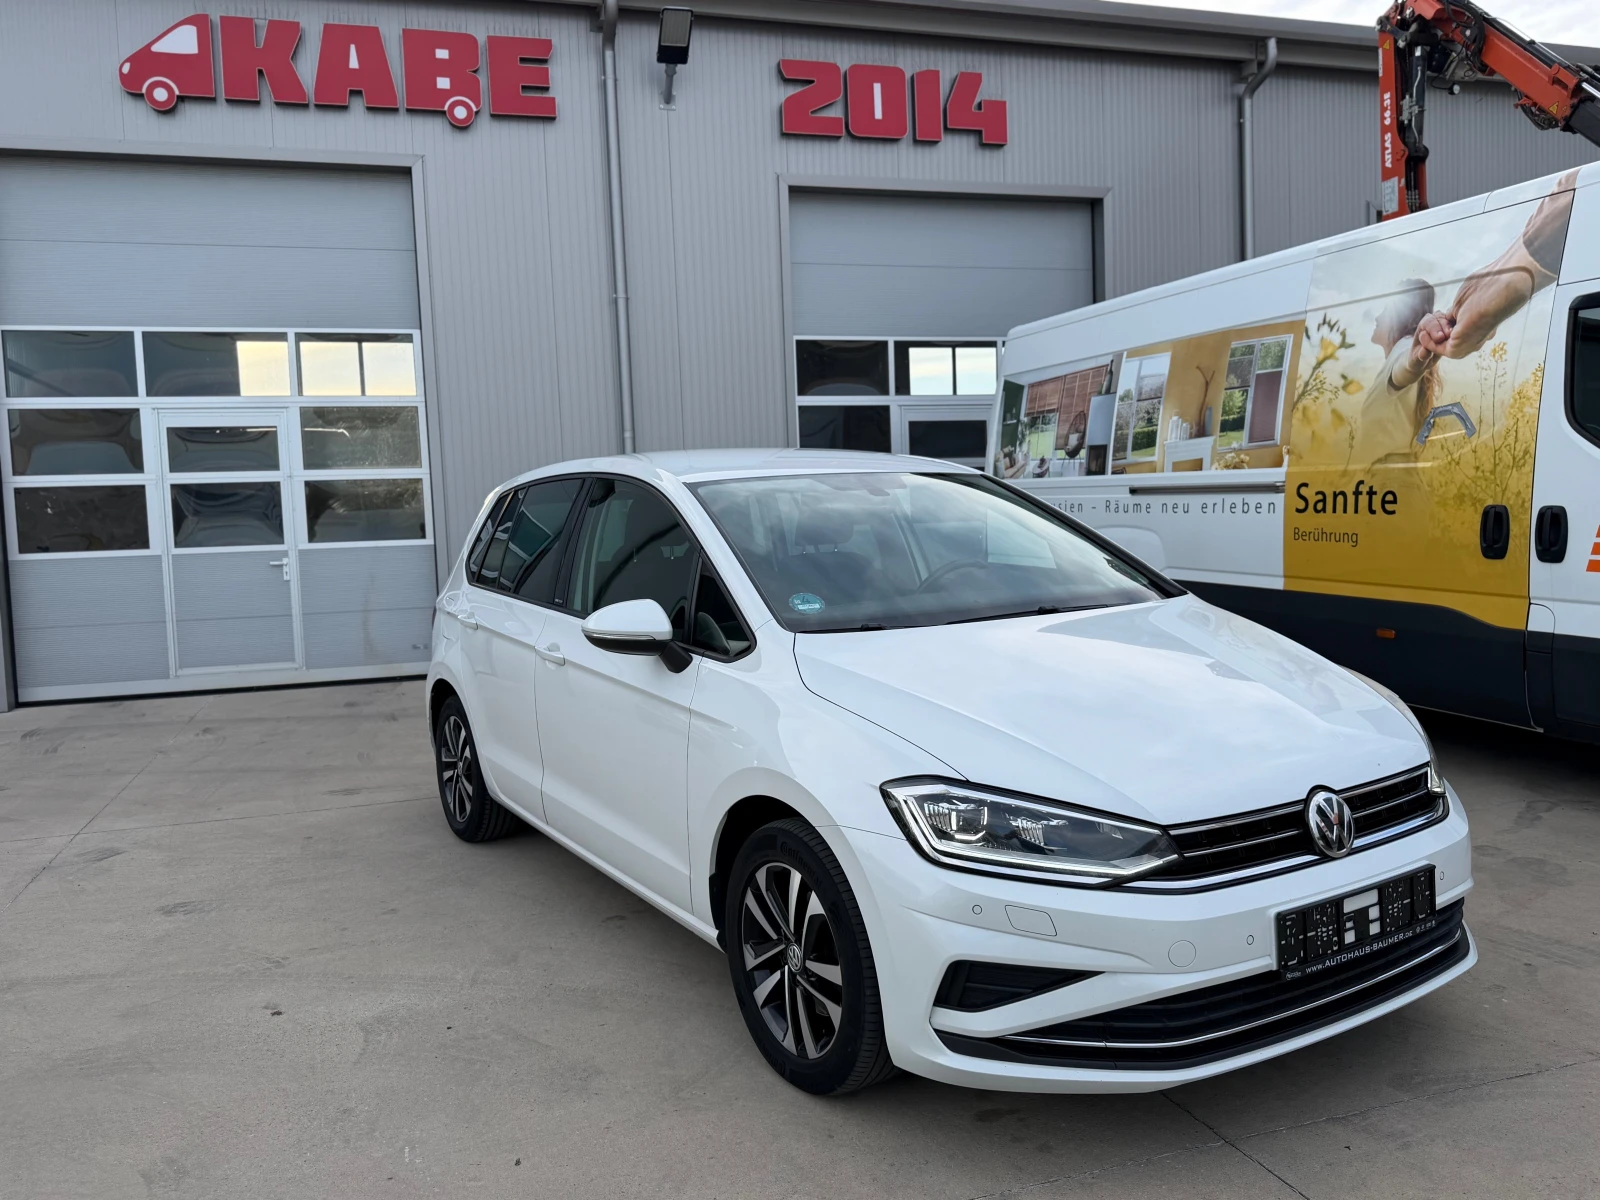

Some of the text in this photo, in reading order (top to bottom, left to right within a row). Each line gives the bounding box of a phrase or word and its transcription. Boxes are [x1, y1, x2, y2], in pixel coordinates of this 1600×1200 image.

[219, 15, 557, 124] KABE
[779, 59, 1008, 145] 2014
[1384, 132, 1392, 168] ATLAS
[1105, 499, 1151, 514] Räume
[1161, 500, 1190, 514] neu
[1201, 497, 1276, 514] erleben
[1295, 480, 1398, 515] Sanfte
[1293, 527, 1359, 547] Berührung
